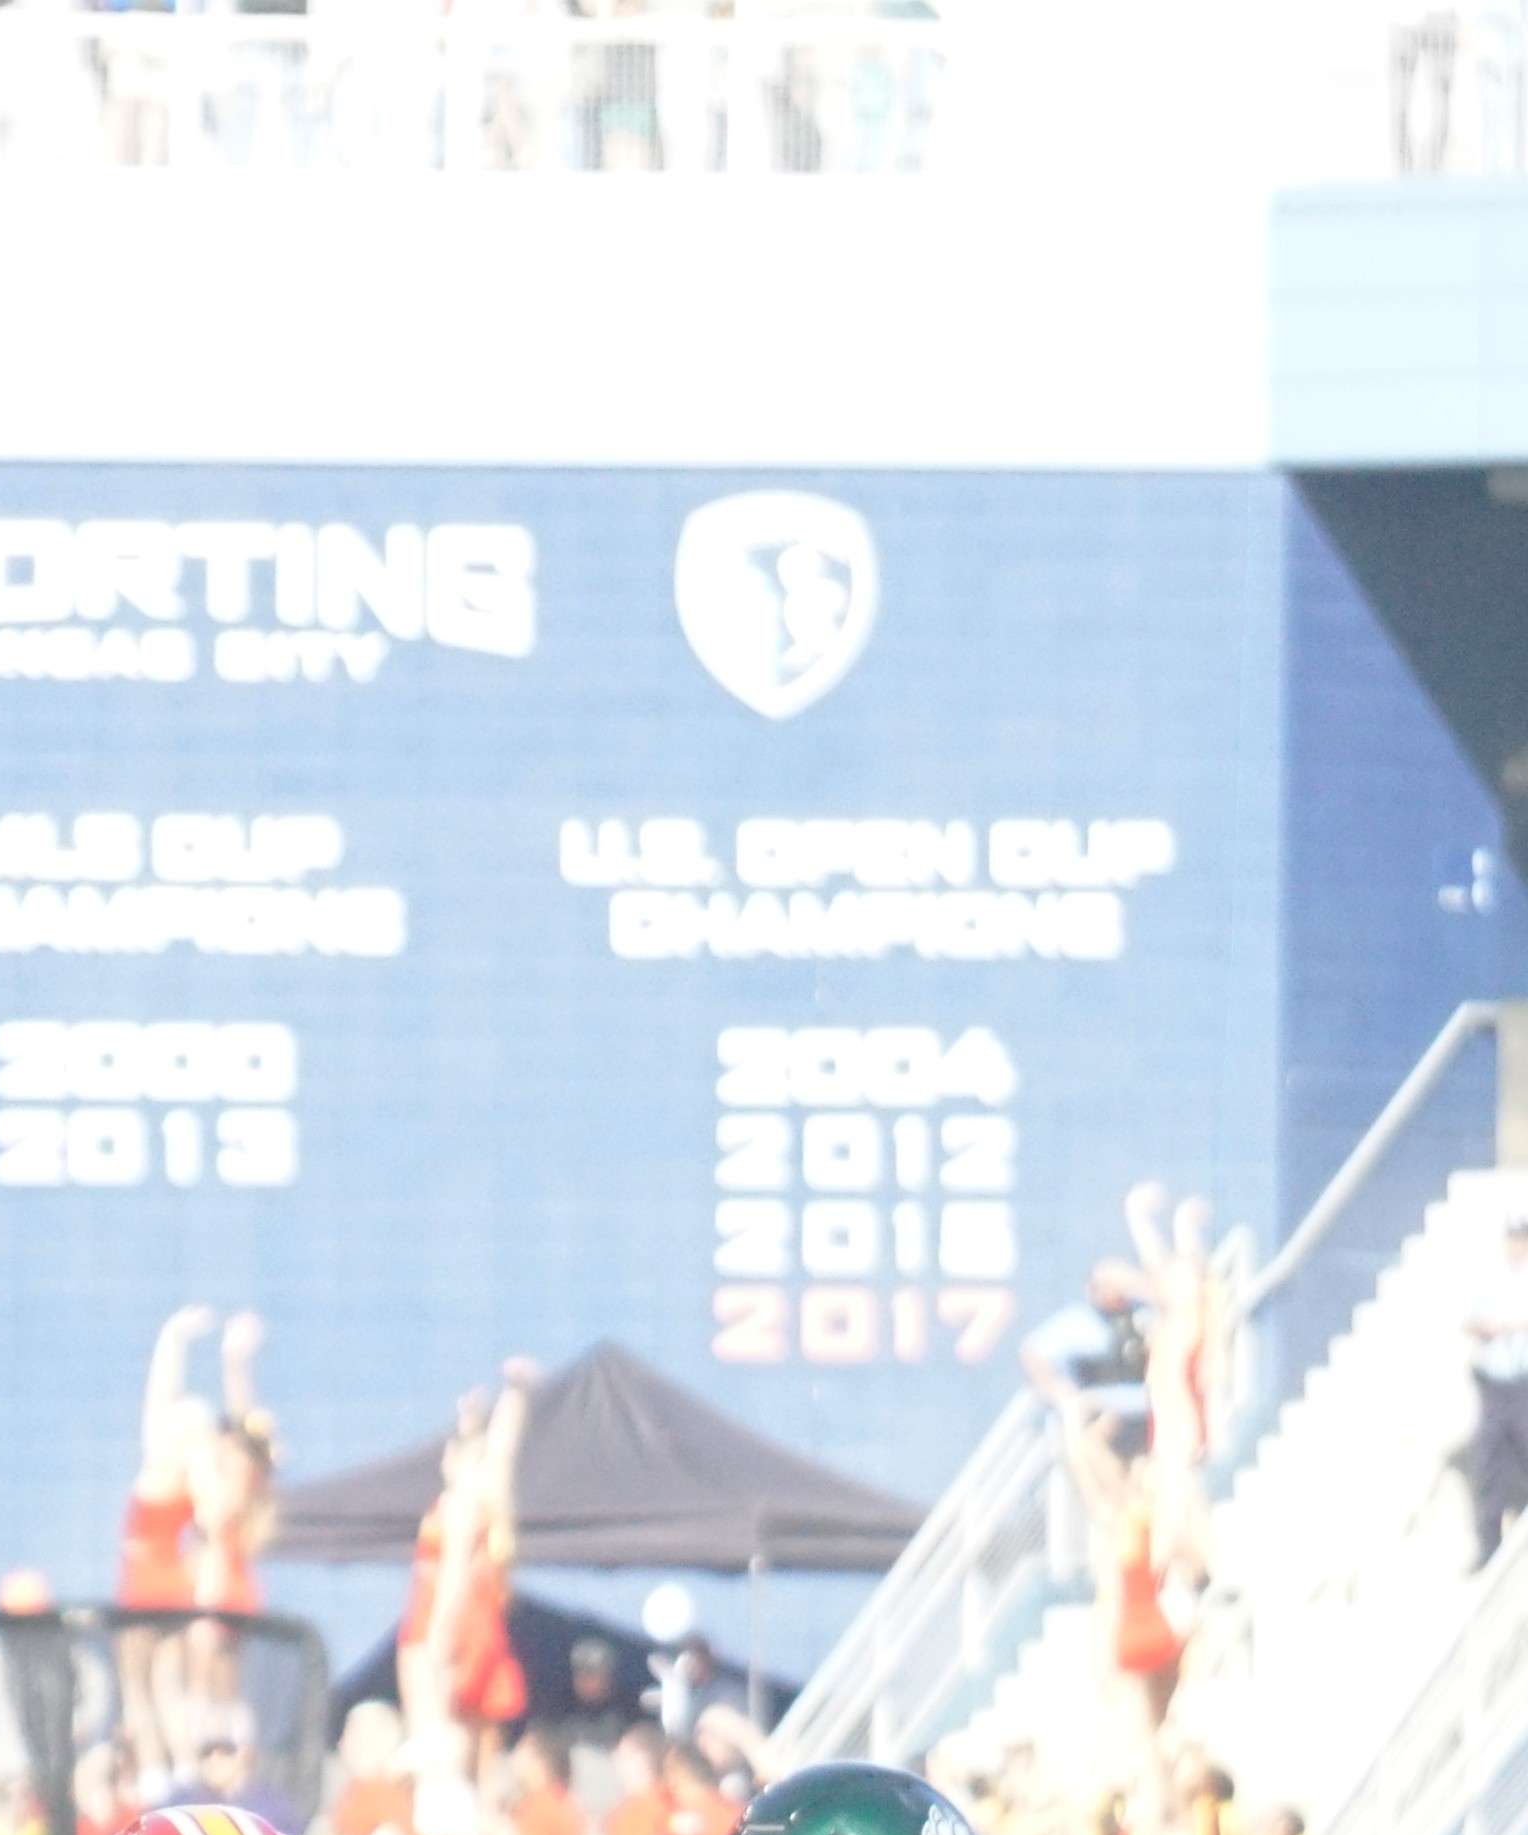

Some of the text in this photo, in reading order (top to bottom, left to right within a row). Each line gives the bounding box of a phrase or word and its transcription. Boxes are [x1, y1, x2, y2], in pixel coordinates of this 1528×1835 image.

[216, 631, 386, 682] CITY
[736, 819, 974, 885] OPEN
[989, 820, 1174, 887] CUP
[609, 891, 1122, 960] CHAMPIONS
[716, 1027, 1018, 1107] 2004
[715, 1113, 1017, 1191] 2012
[712, 1285, 1016, 1363] 2017
